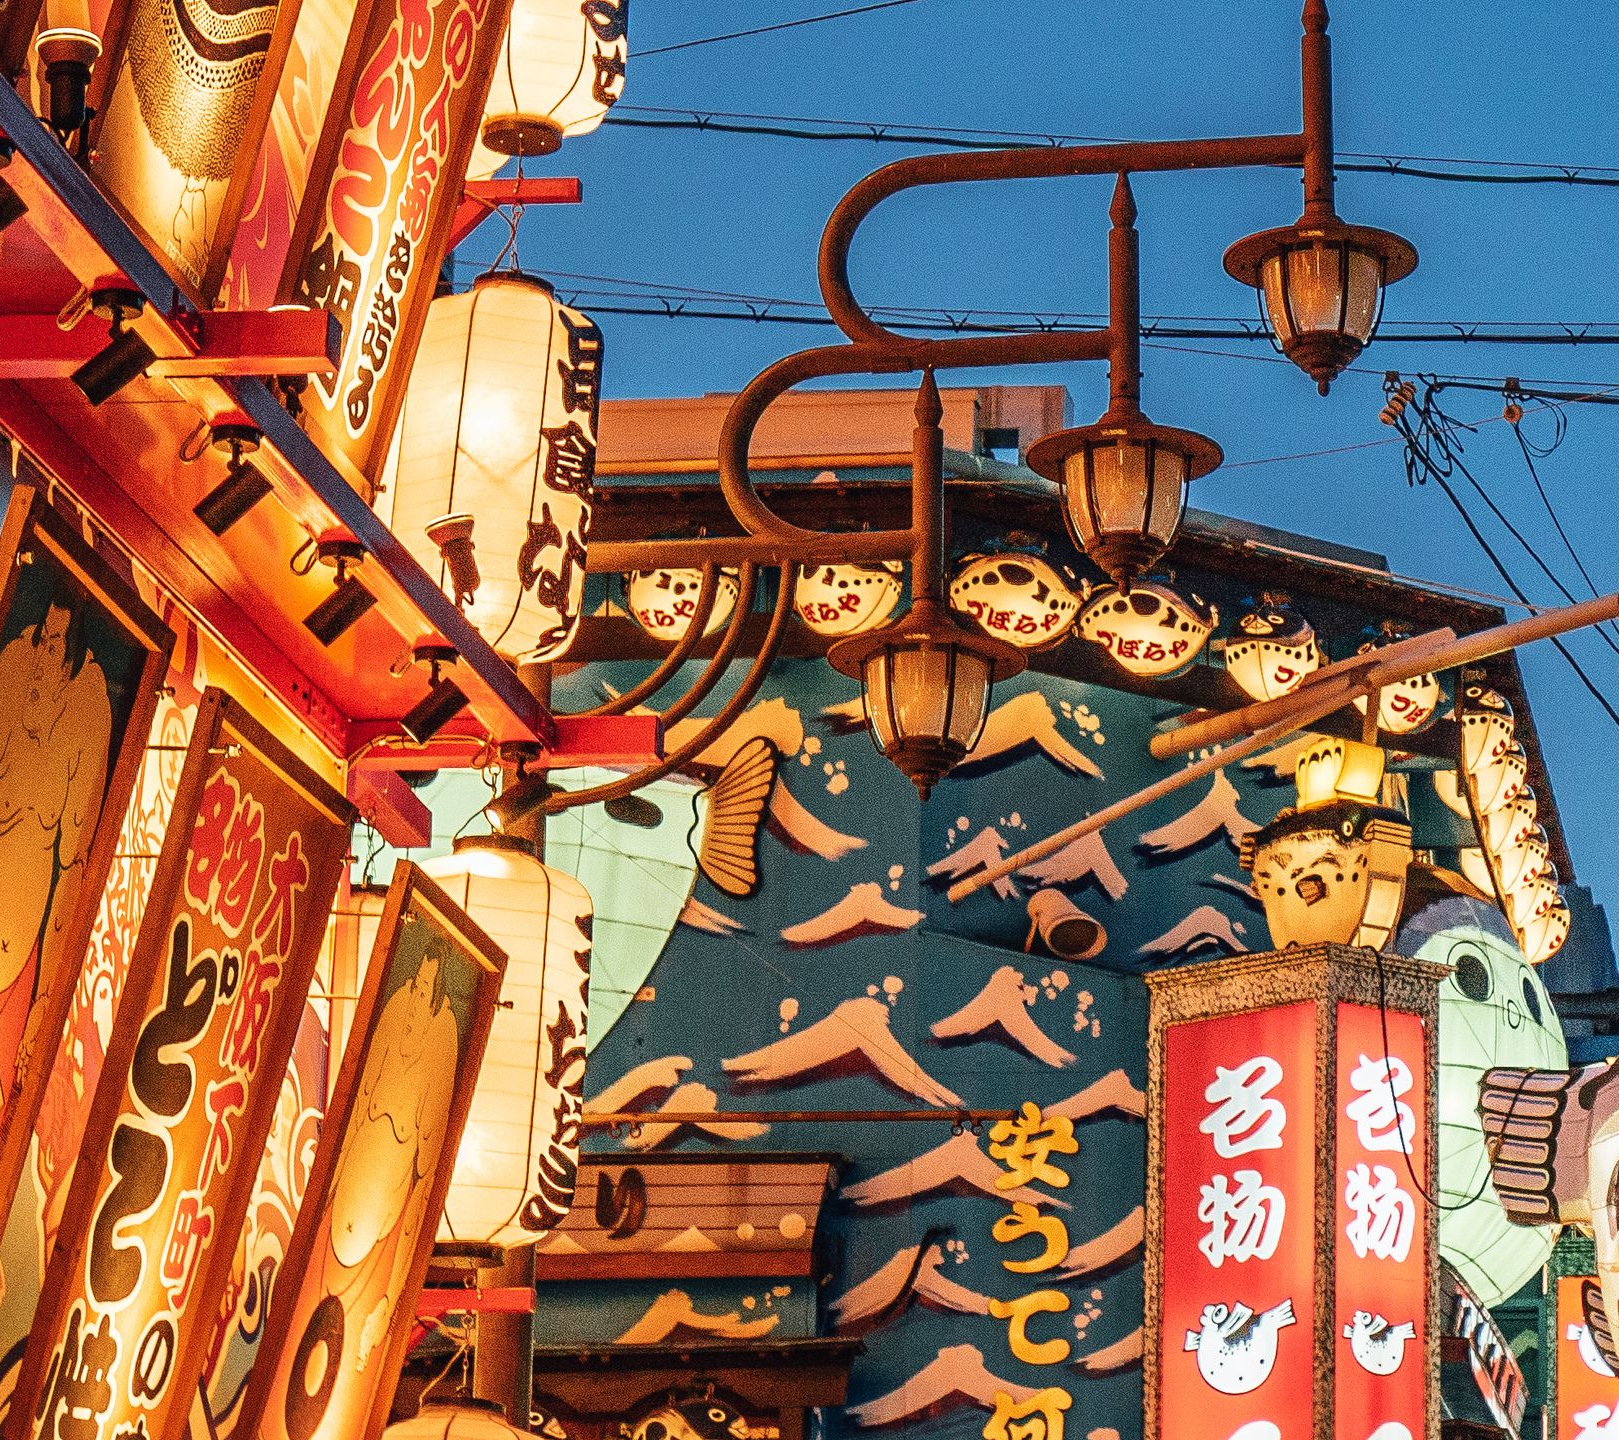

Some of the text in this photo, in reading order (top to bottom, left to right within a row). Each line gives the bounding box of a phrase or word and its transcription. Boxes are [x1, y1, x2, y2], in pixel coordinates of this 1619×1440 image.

[185, 770, 264, 935] 名物
[1198, 1055, 1286, 1268] 名物
[1342, 1053, 1415, 1264] 名物
